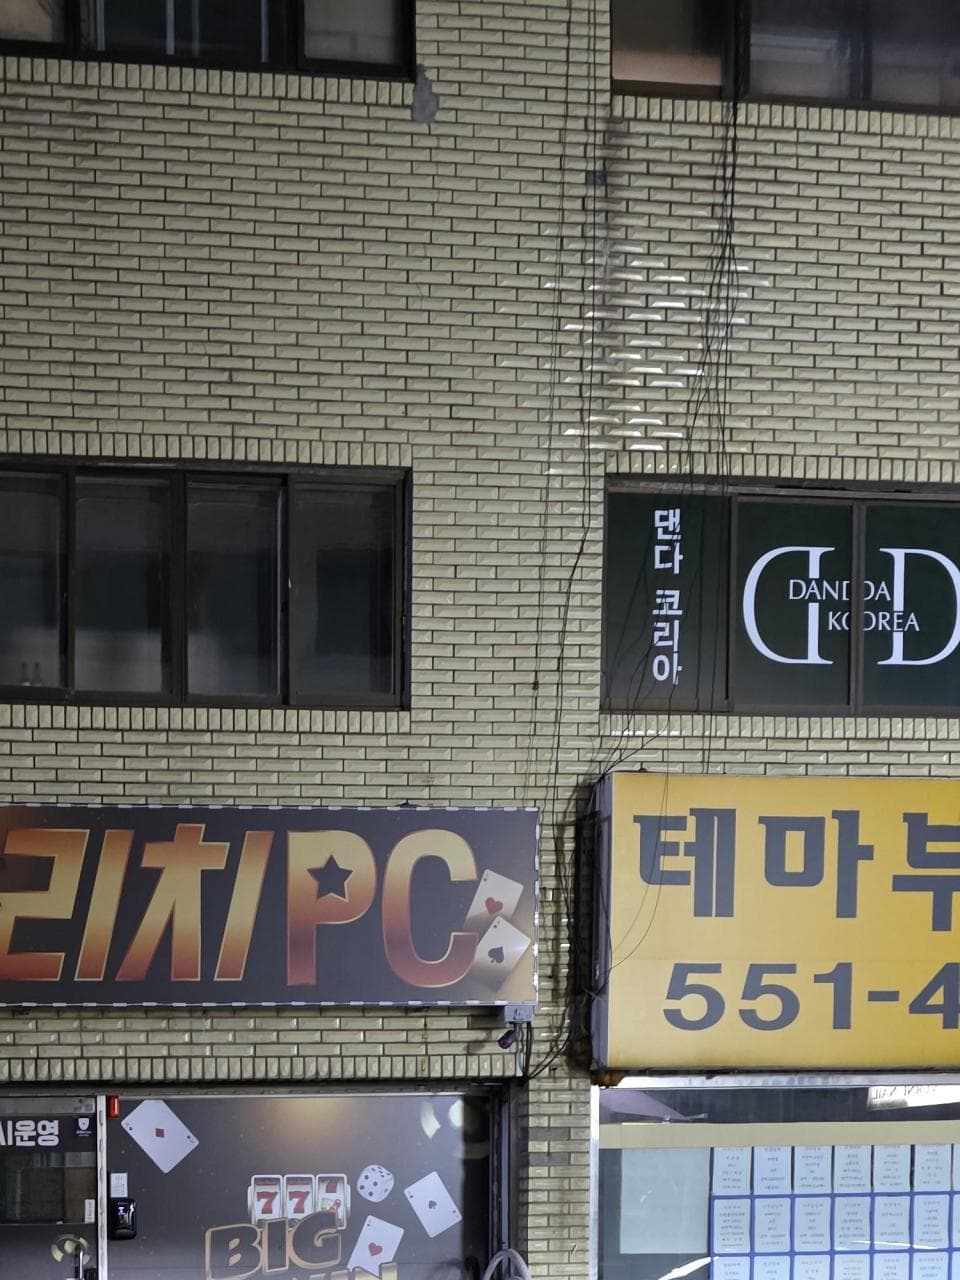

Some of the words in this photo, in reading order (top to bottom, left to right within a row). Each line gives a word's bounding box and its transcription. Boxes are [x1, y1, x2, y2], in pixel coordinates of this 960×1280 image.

[654, 508, 684, 575] 댄다
[652, 589, 683, 685] 코리아
[663, 962, 960, 1031] 551-4
